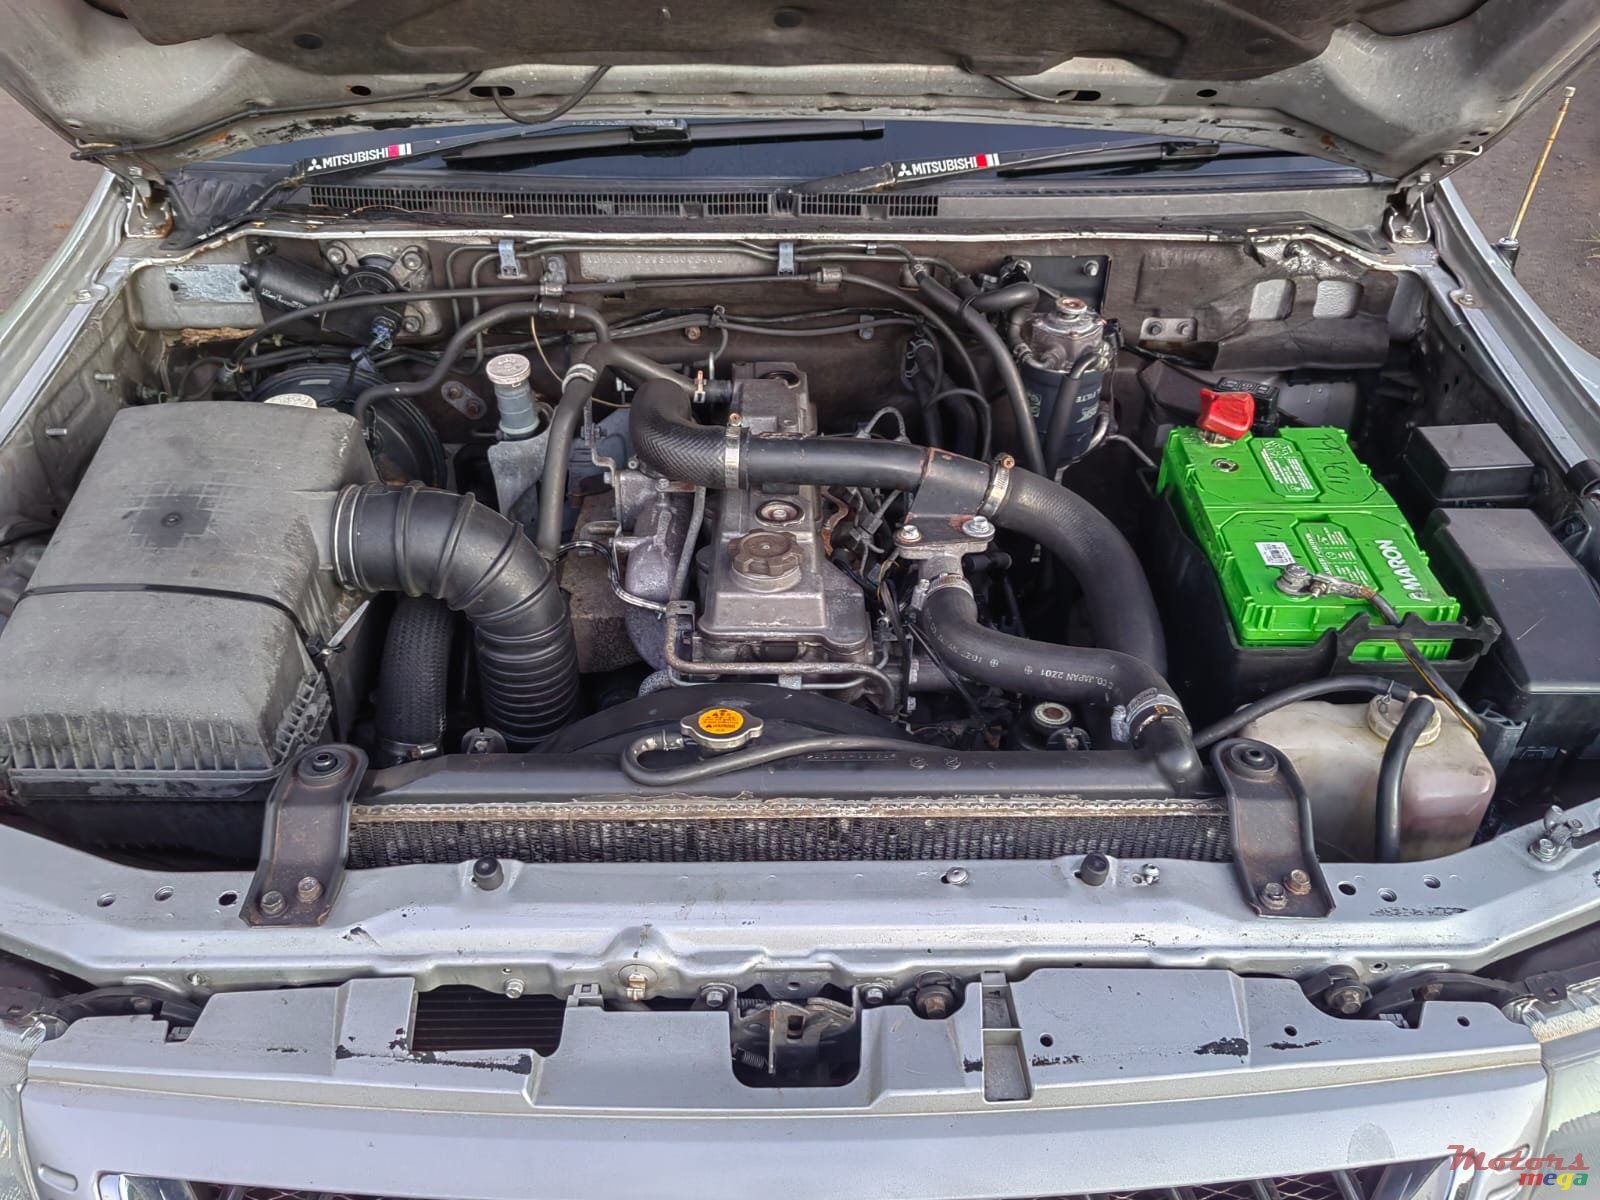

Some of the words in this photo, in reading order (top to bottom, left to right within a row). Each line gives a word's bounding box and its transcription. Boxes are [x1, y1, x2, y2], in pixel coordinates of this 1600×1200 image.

[321, 147, 389, 169] MITSUBISHI
[911, 155, 977, 175] MITSUBISHI
[1375, 539, 1432, 602] AMARON
[1066, 672, 1095, 684] JAPAN
